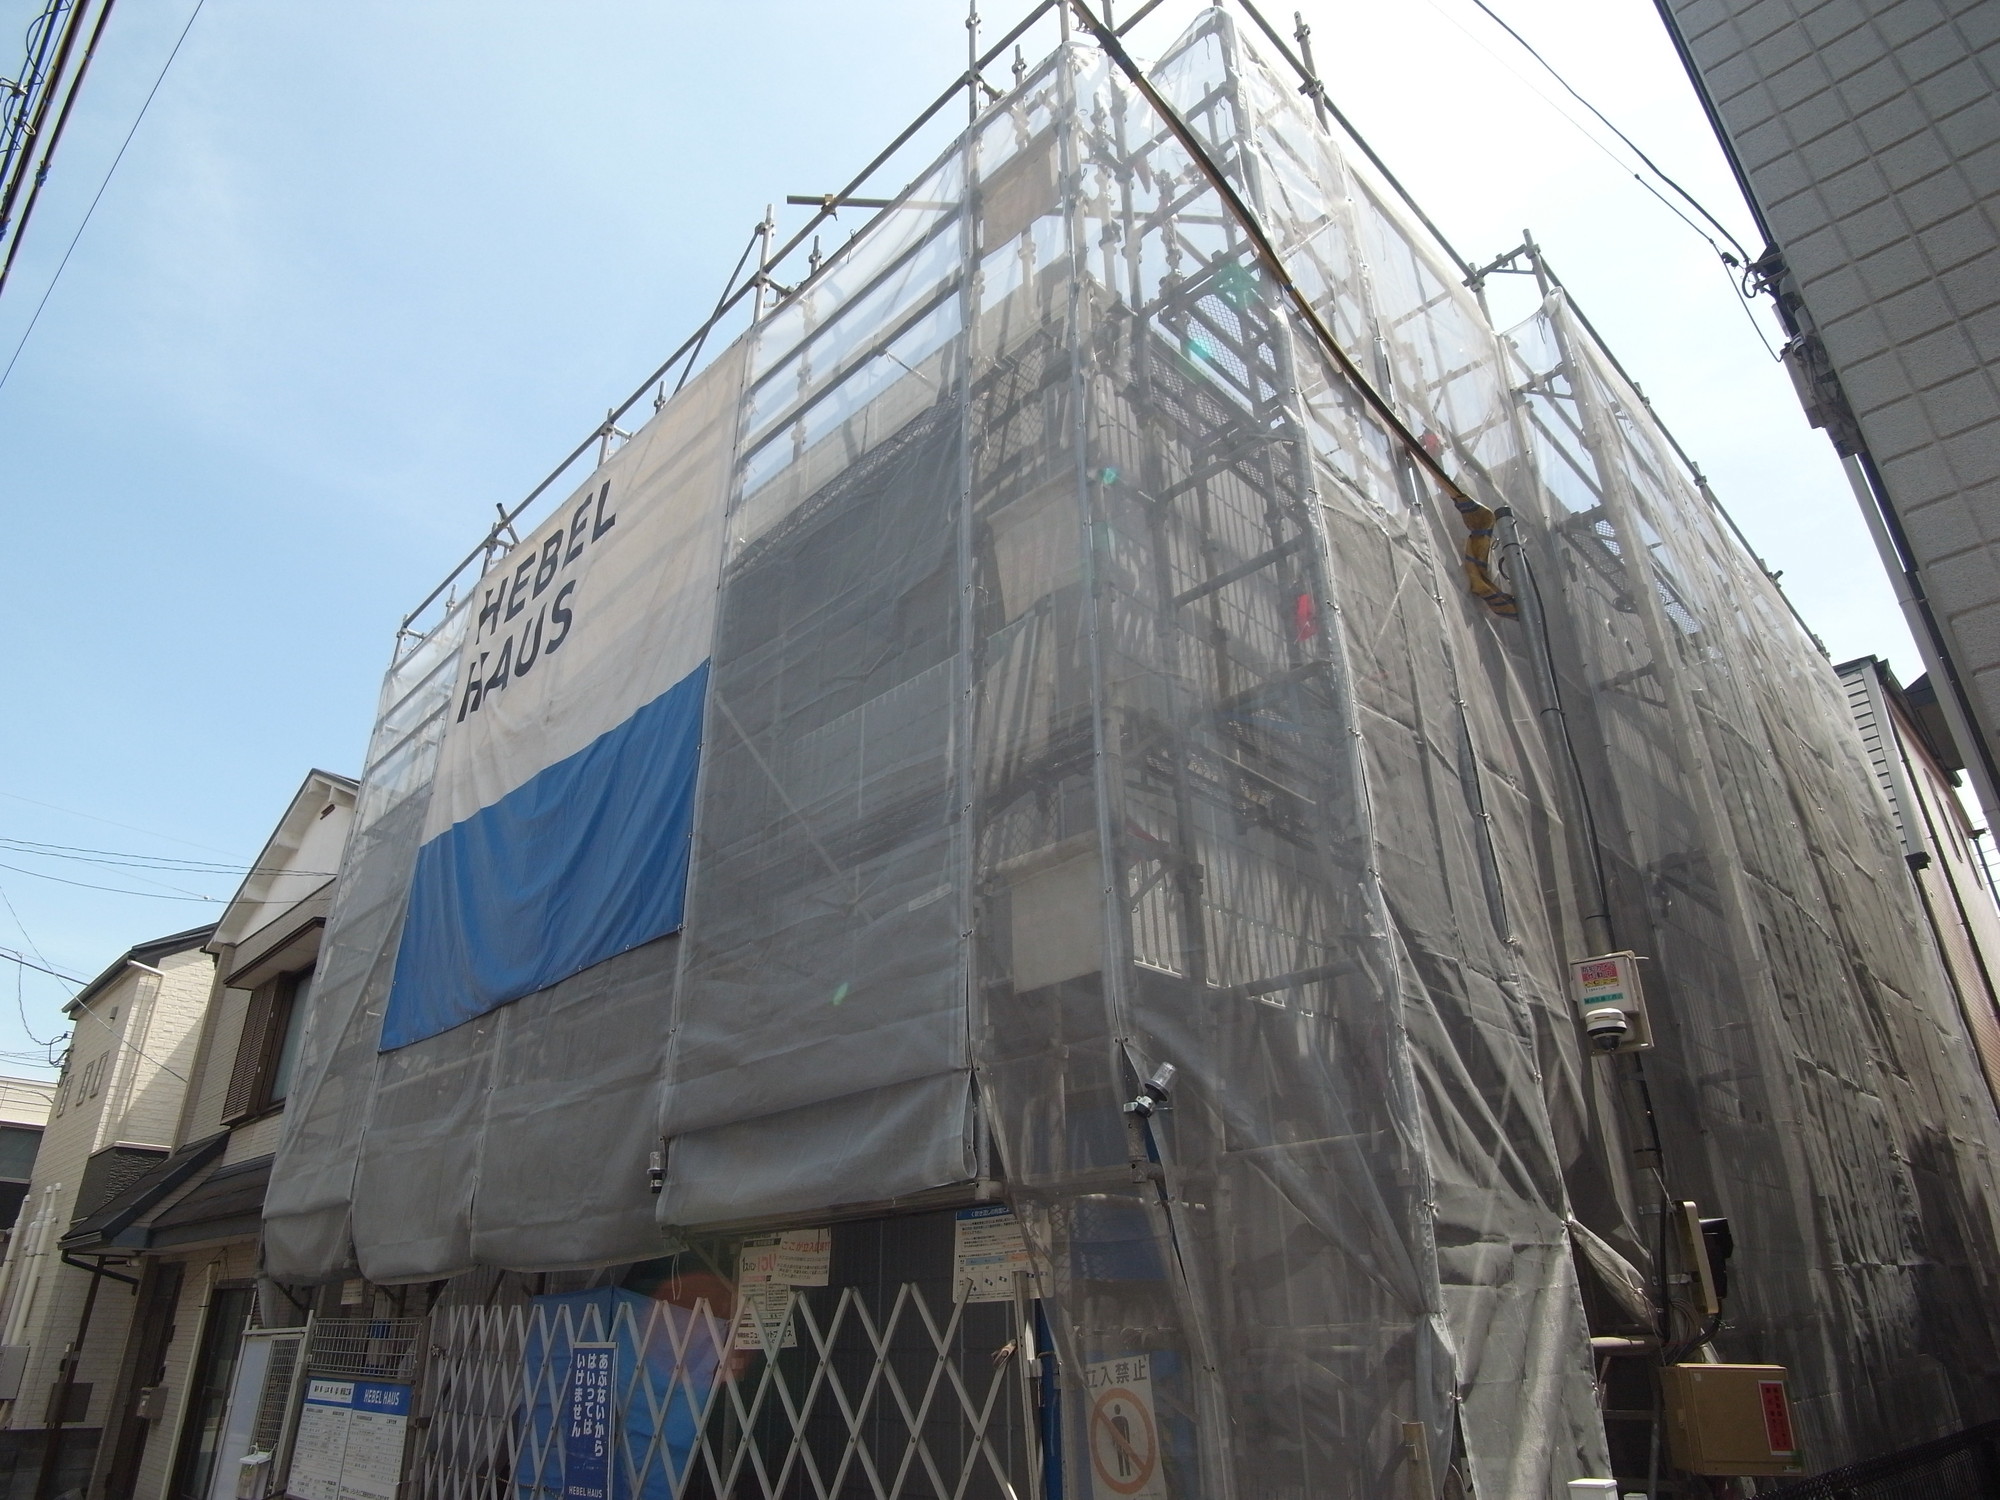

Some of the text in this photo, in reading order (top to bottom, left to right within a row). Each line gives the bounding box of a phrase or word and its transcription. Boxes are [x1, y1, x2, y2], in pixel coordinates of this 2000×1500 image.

[475, 479, 616, 645] HEBEL
[457, 579, 576, 723] HAUS
[363, 1388, 400, 1406] HEBEL HAUS
[571, 1353, 585, 1438] いけません
[583, 1353, 597, 1435] はいっては
[594, 1353, 609, 1457] あぶないから
[1085, 1359, 1148, 1388] 立入禁止
[568, 1485, 603, 1499] HEBEL HAUS
